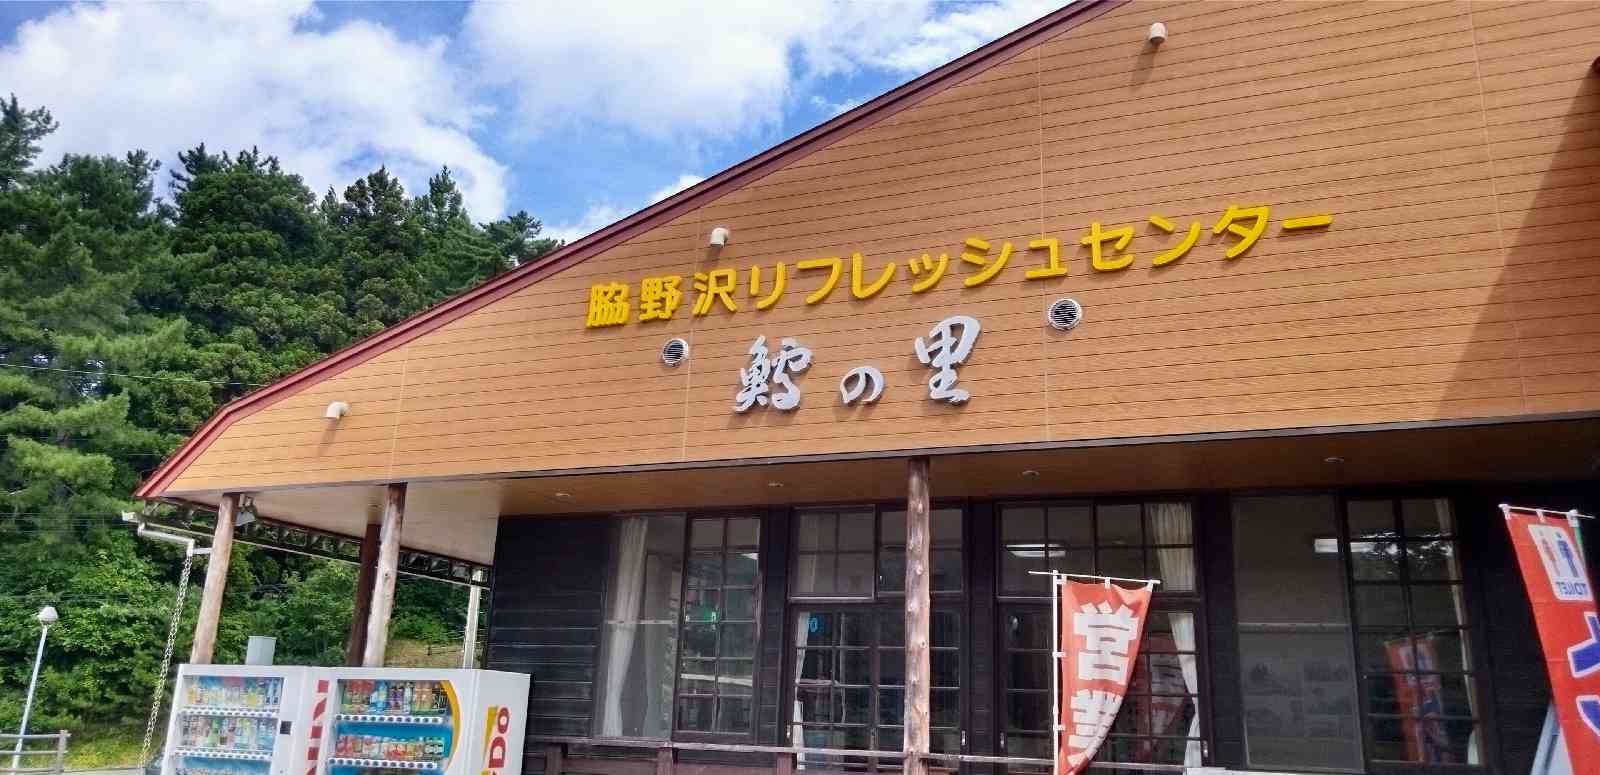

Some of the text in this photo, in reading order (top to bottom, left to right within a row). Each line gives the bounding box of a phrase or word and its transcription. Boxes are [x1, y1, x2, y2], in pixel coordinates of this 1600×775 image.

[586, 205, 1333, 328] 脇野沢リフレッシュセンター
[735, 315, 981, 413] 鱈の里
